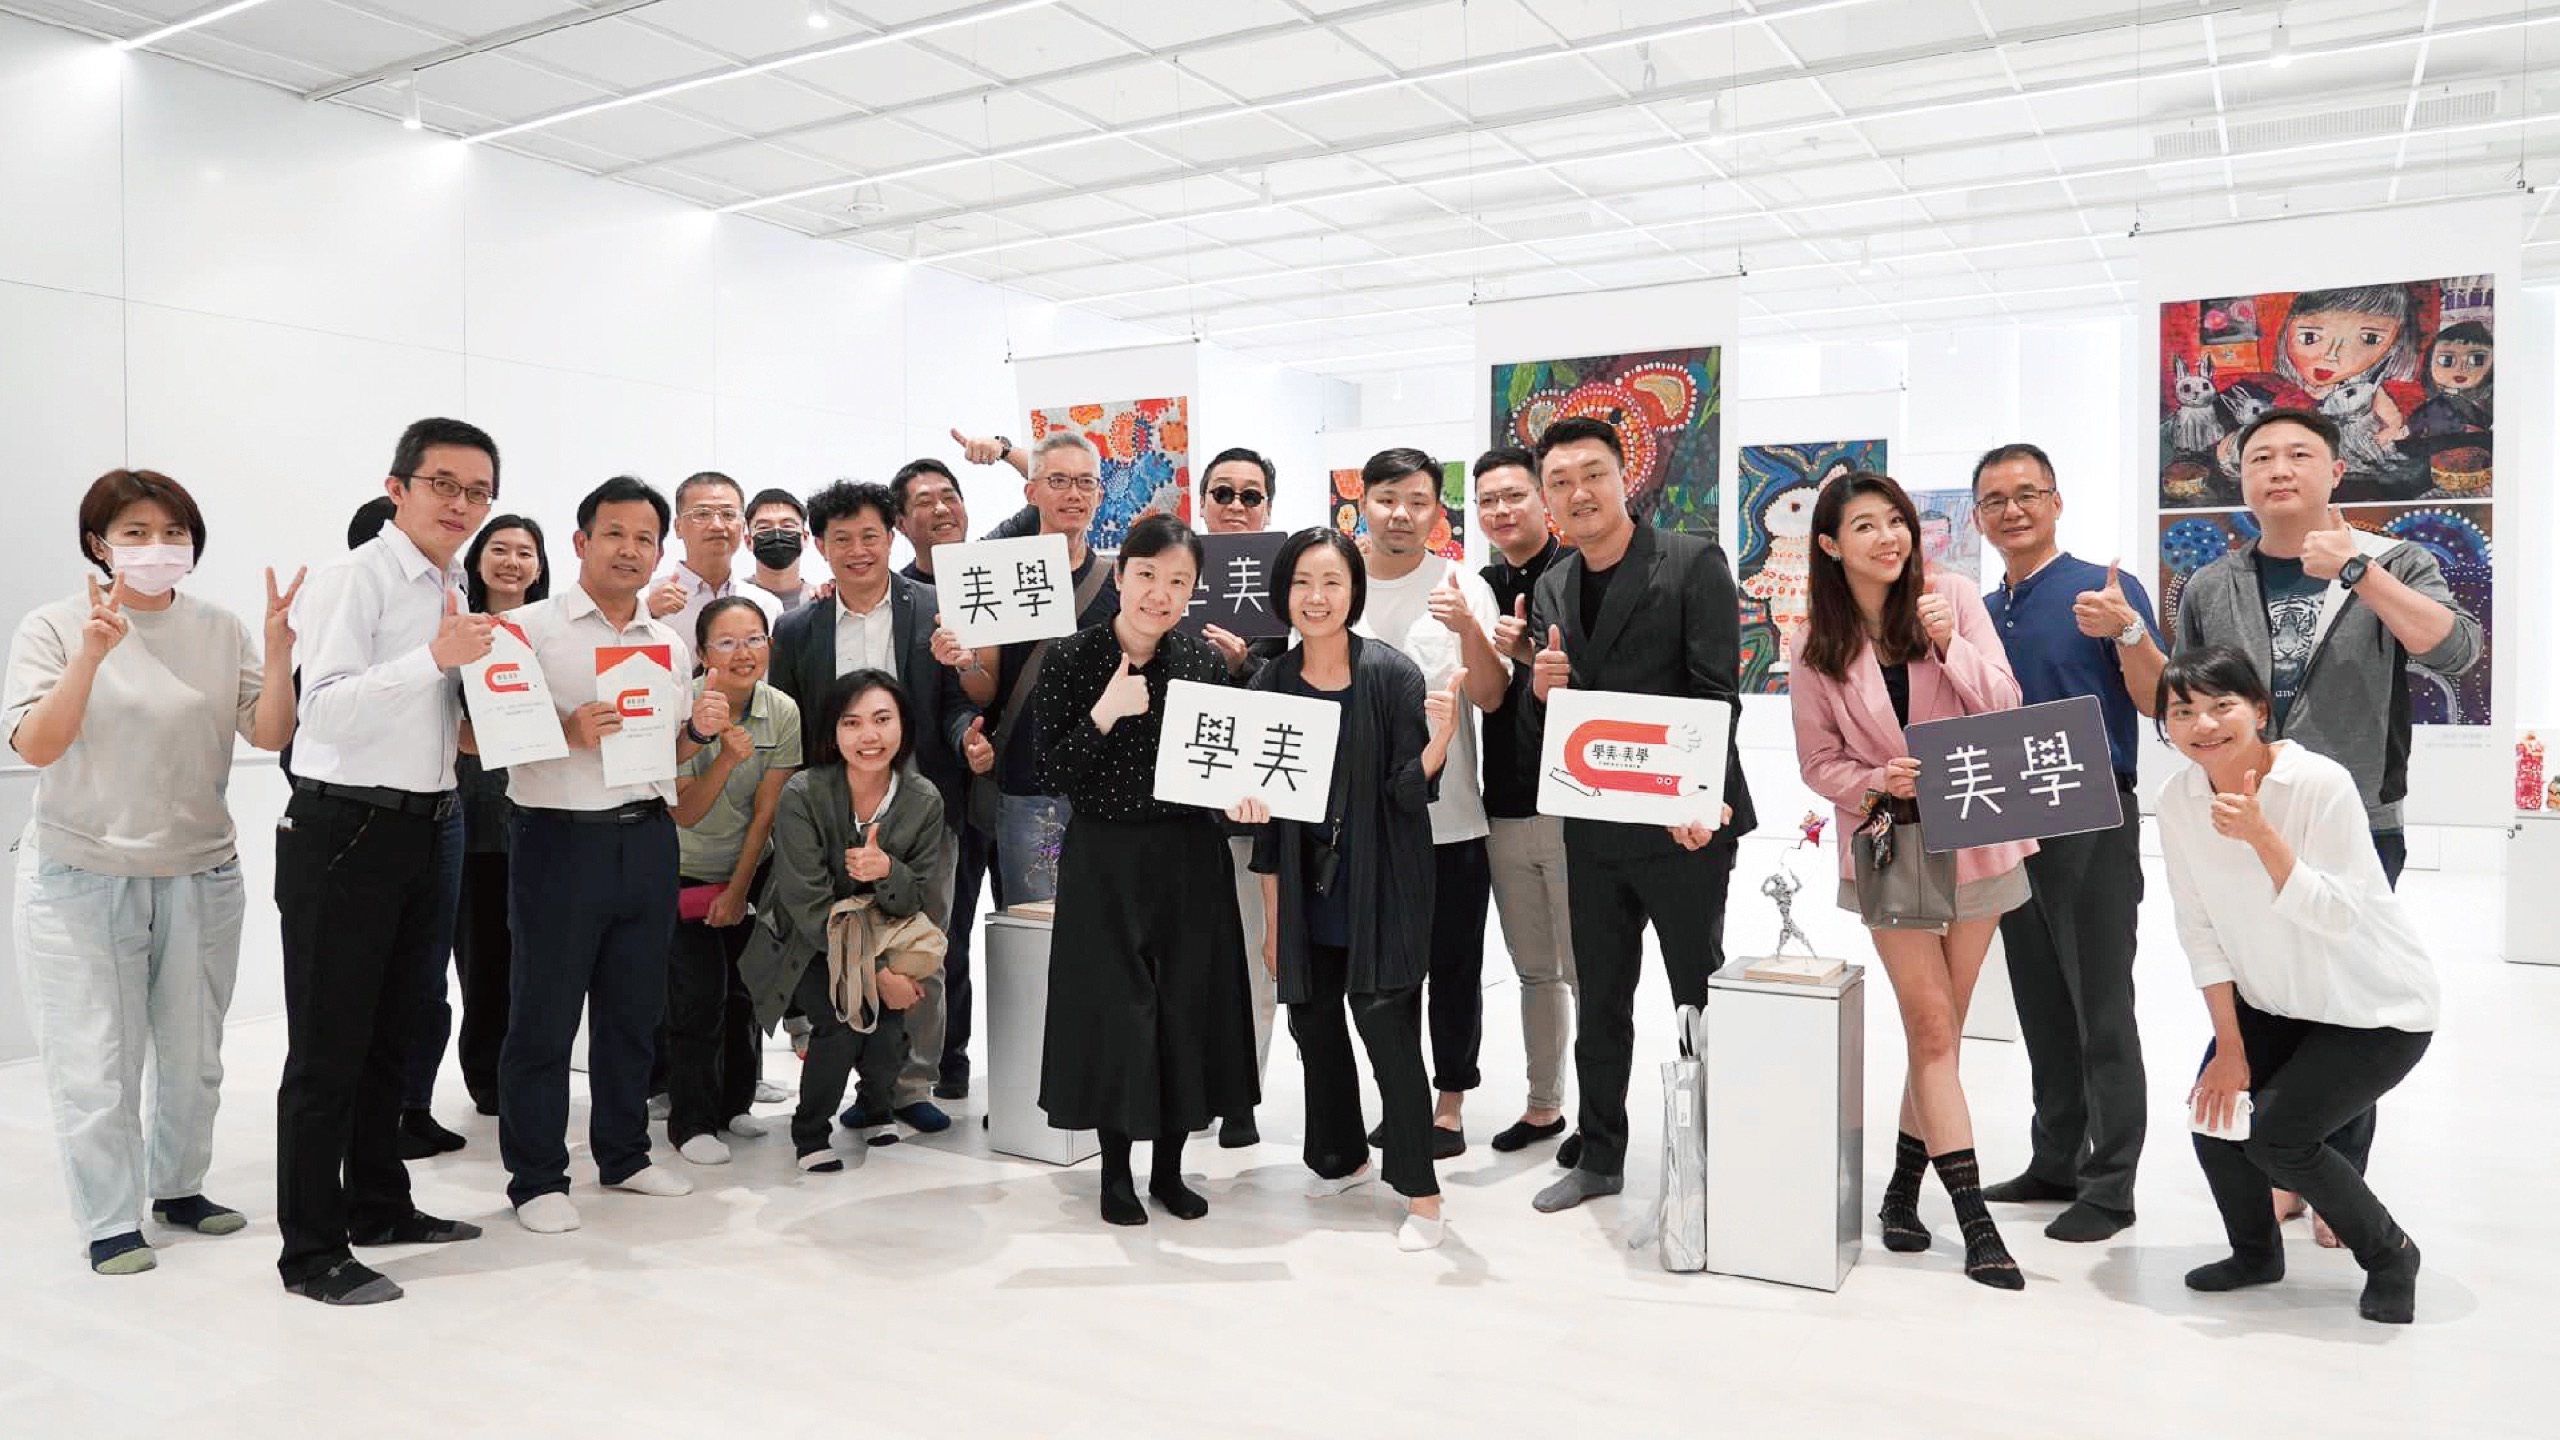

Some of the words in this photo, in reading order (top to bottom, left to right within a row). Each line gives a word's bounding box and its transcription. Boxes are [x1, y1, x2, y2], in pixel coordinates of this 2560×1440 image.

[960, 560, 1054, 624] 美學
[1185, 712, 1308, 792] 學美
[1944, 730, 2084, 820] 美學
